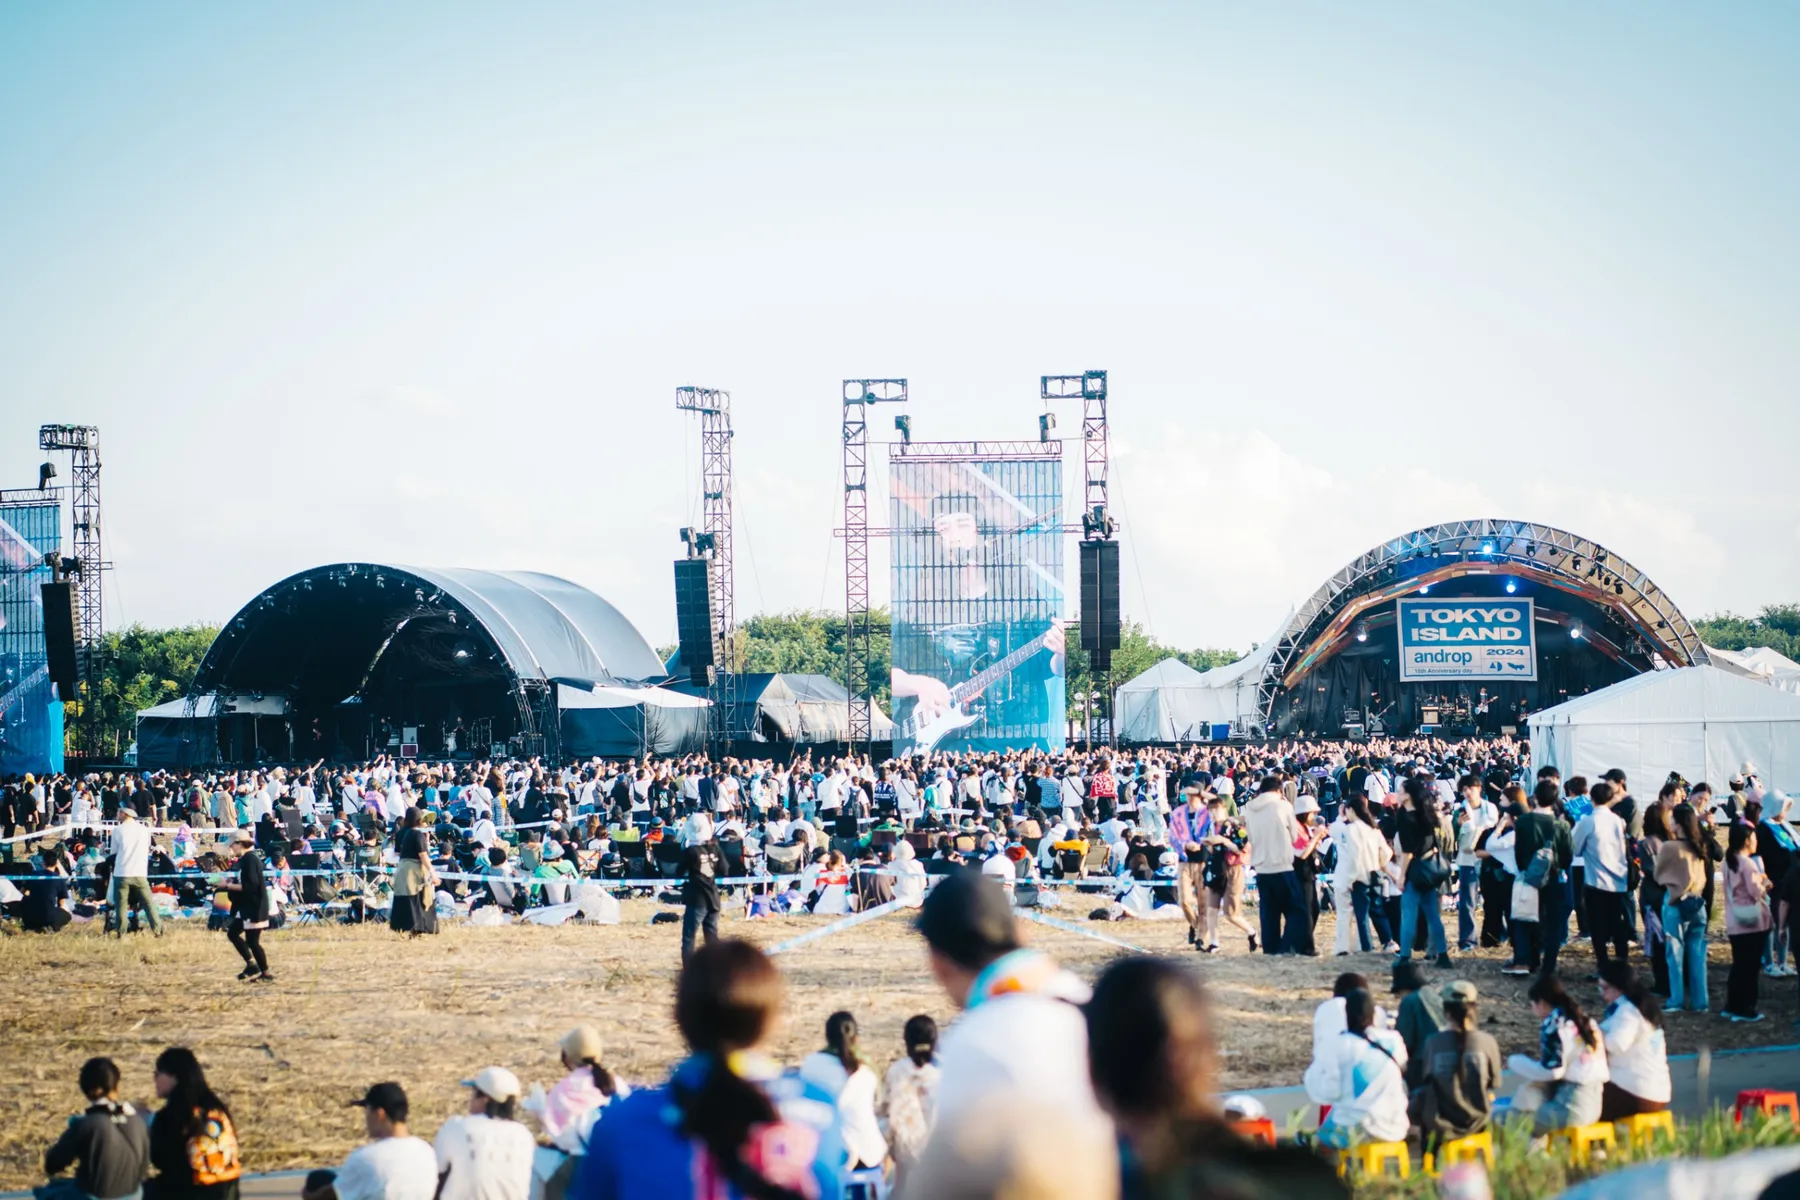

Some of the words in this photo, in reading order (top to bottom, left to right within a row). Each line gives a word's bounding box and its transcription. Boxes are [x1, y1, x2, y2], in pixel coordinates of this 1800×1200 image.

[1410, 608, 1521, 623] TOKYO
[1411, 627, 1522, 641] ISLAND
[1414, 649, 1473, 666] androp
[1486, 648, 1525, 656] 2024
